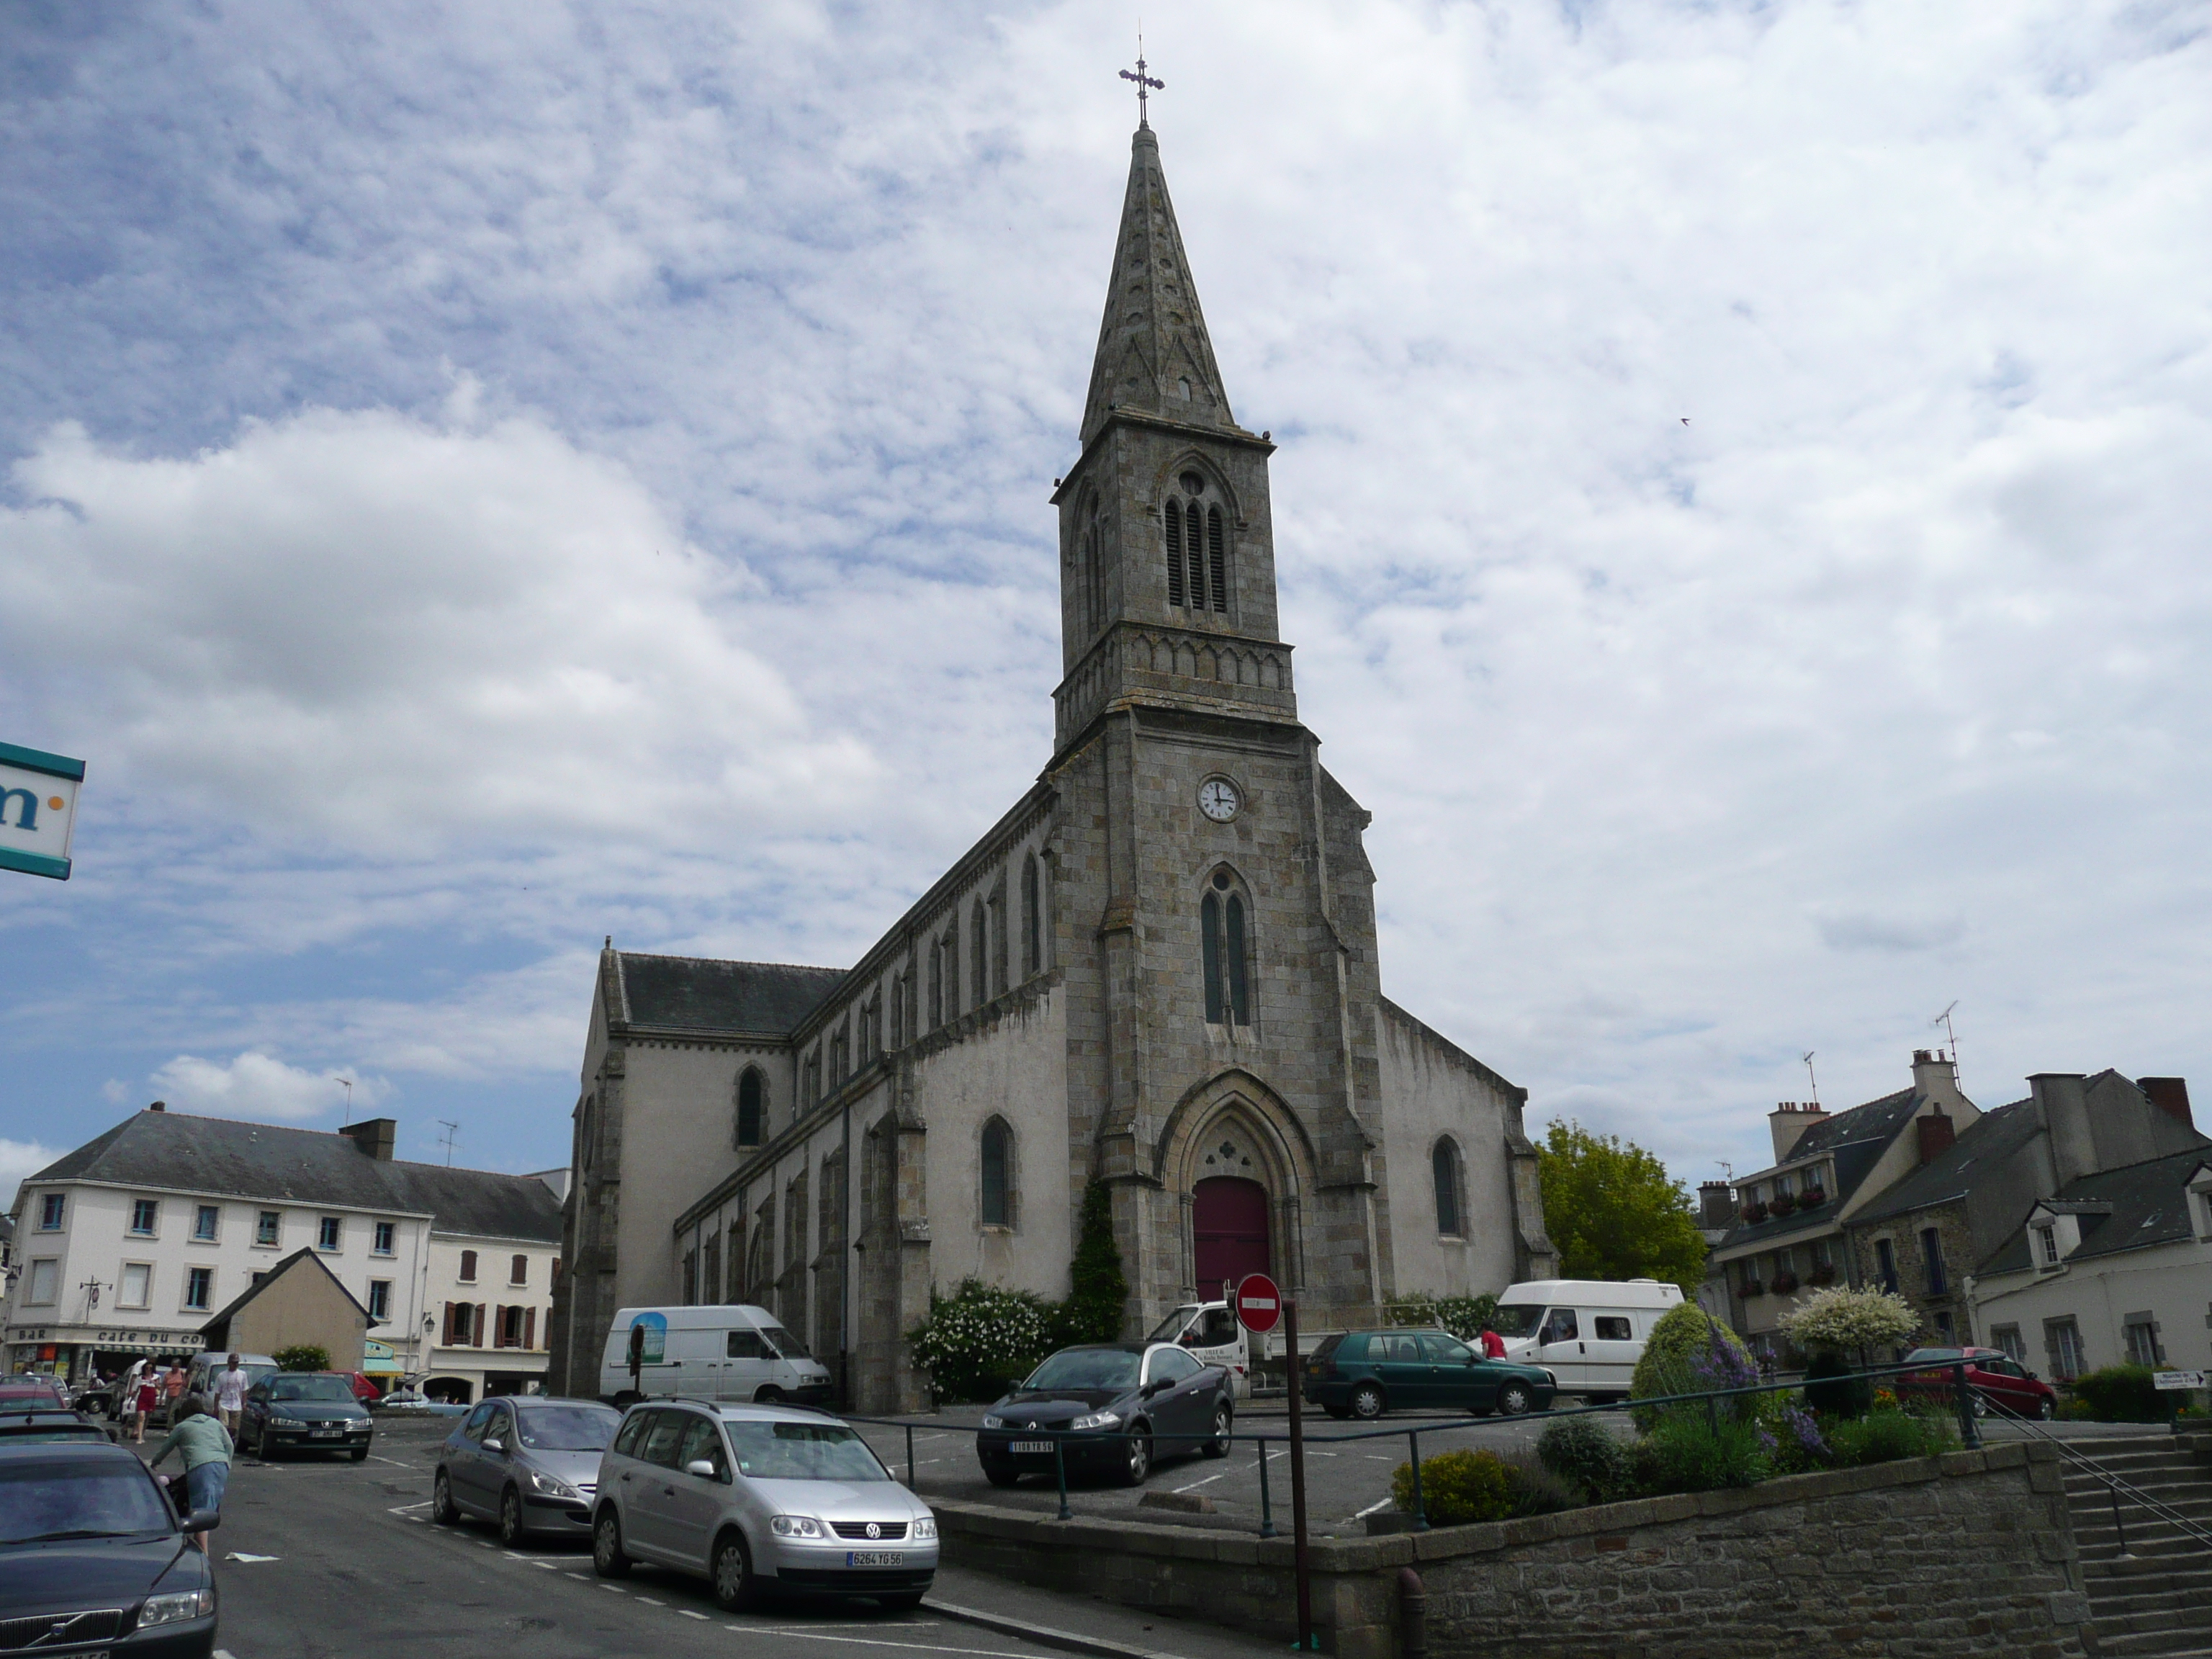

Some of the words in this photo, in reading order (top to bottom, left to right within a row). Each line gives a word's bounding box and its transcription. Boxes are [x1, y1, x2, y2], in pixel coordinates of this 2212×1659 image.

[150, 1333, 168, 1343] DU
[1043, 1442, 1052, 1451] 56
[854, 1553, 876, 1565] 6264
[879, 1553, 889, 1565] YG
[891, 1553, 901, 1565] 56
